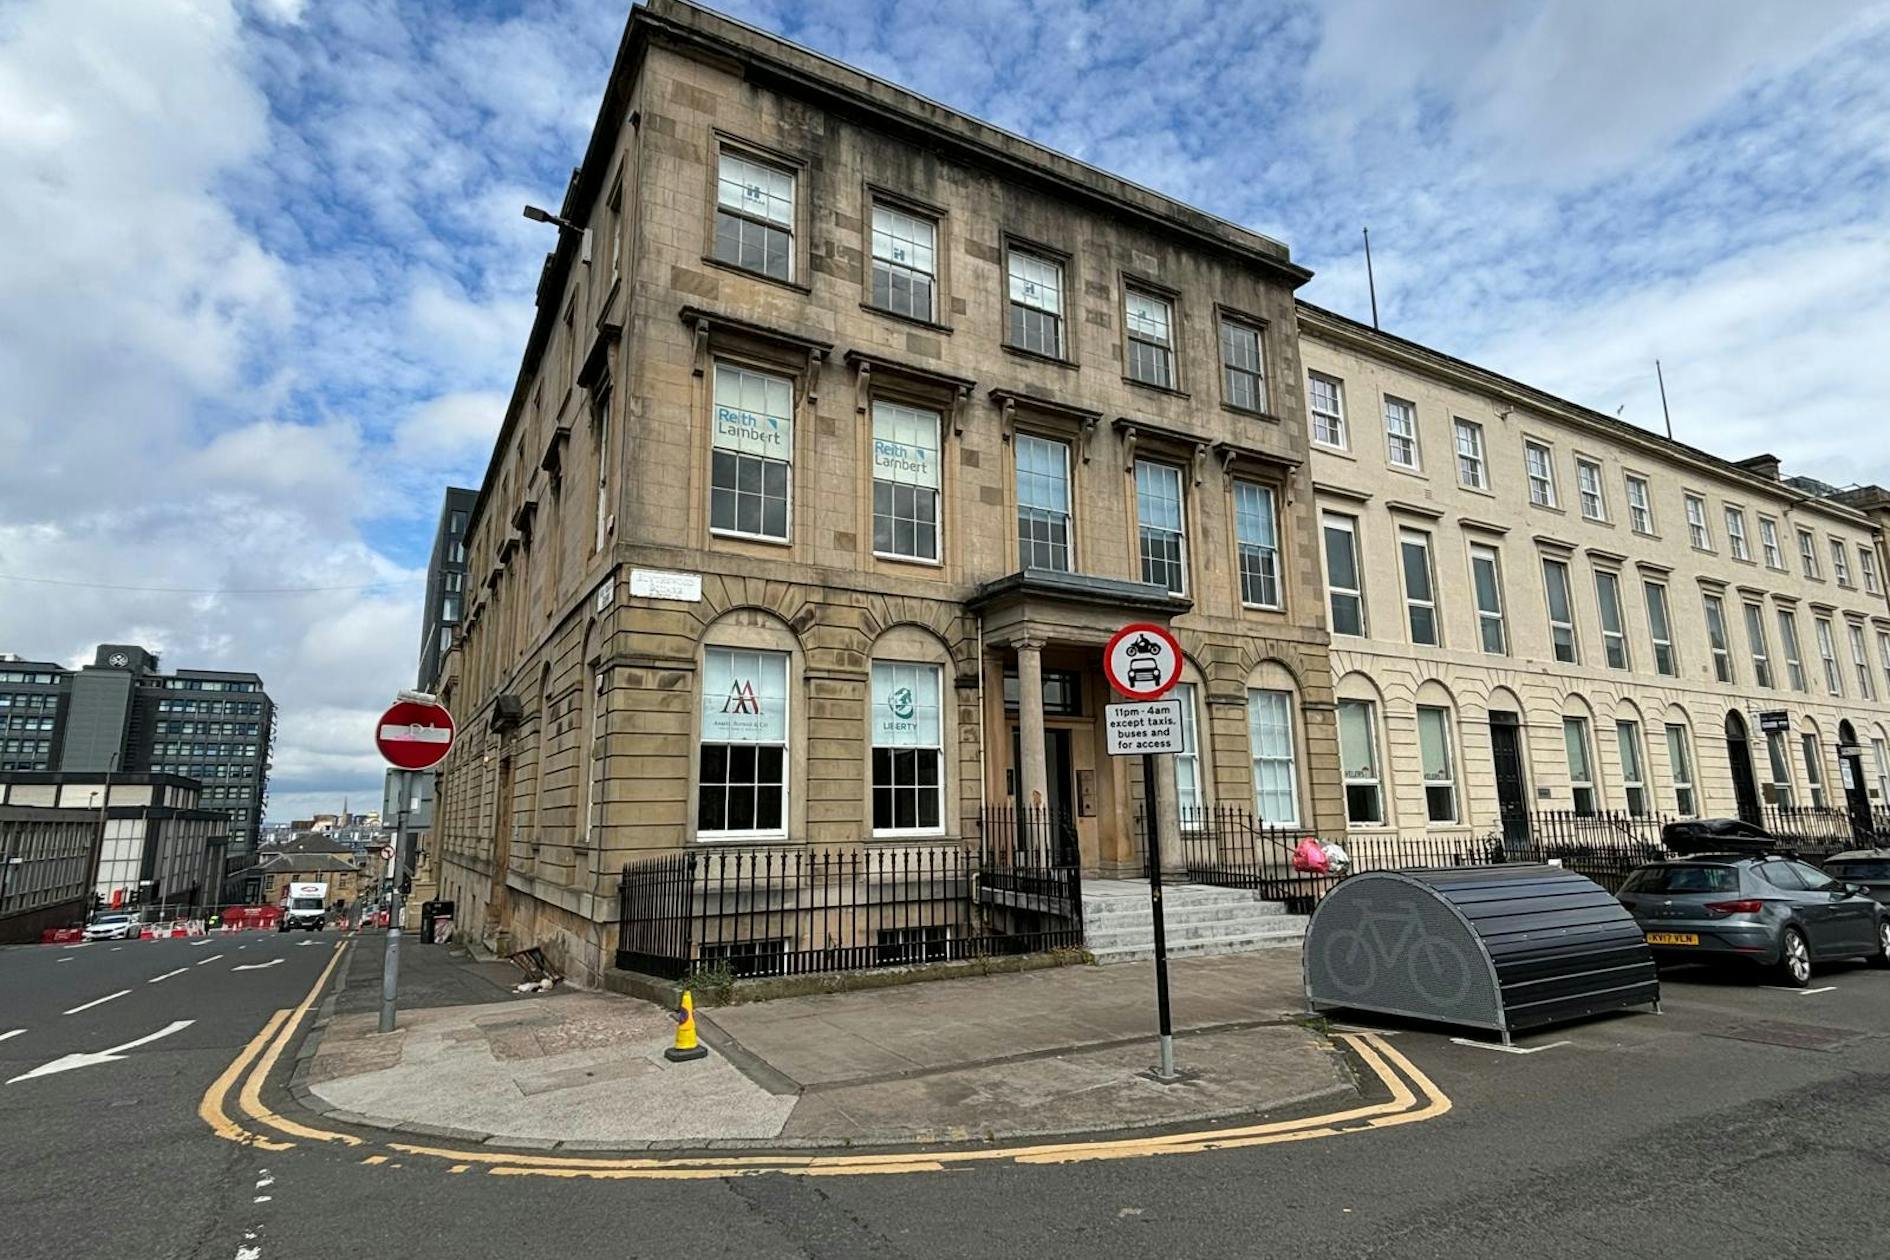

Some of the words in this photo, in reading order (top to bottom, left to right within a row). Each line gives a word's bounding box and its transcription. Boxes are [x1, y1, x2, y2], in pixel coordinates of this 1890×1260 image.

[719, 408, 756, 427] Reith
[719, 422, 781, 445] Lambert
[875, 441, 907, 459] Reith
[875, 455, 927, 474] Lambert
[1115, 708, 1139, 717] 11pm
[1147, 706, 1170, 714] 4am
[883, 721, 918, 731] LIBERTY
[1110, 718, 1145, 728] except
[1118, 729, 1148, 739] buses
[1151, 727, 1170, 737] and
[1118, 740, 1132, 749] for
[1136, 741, 1171, 749] access
